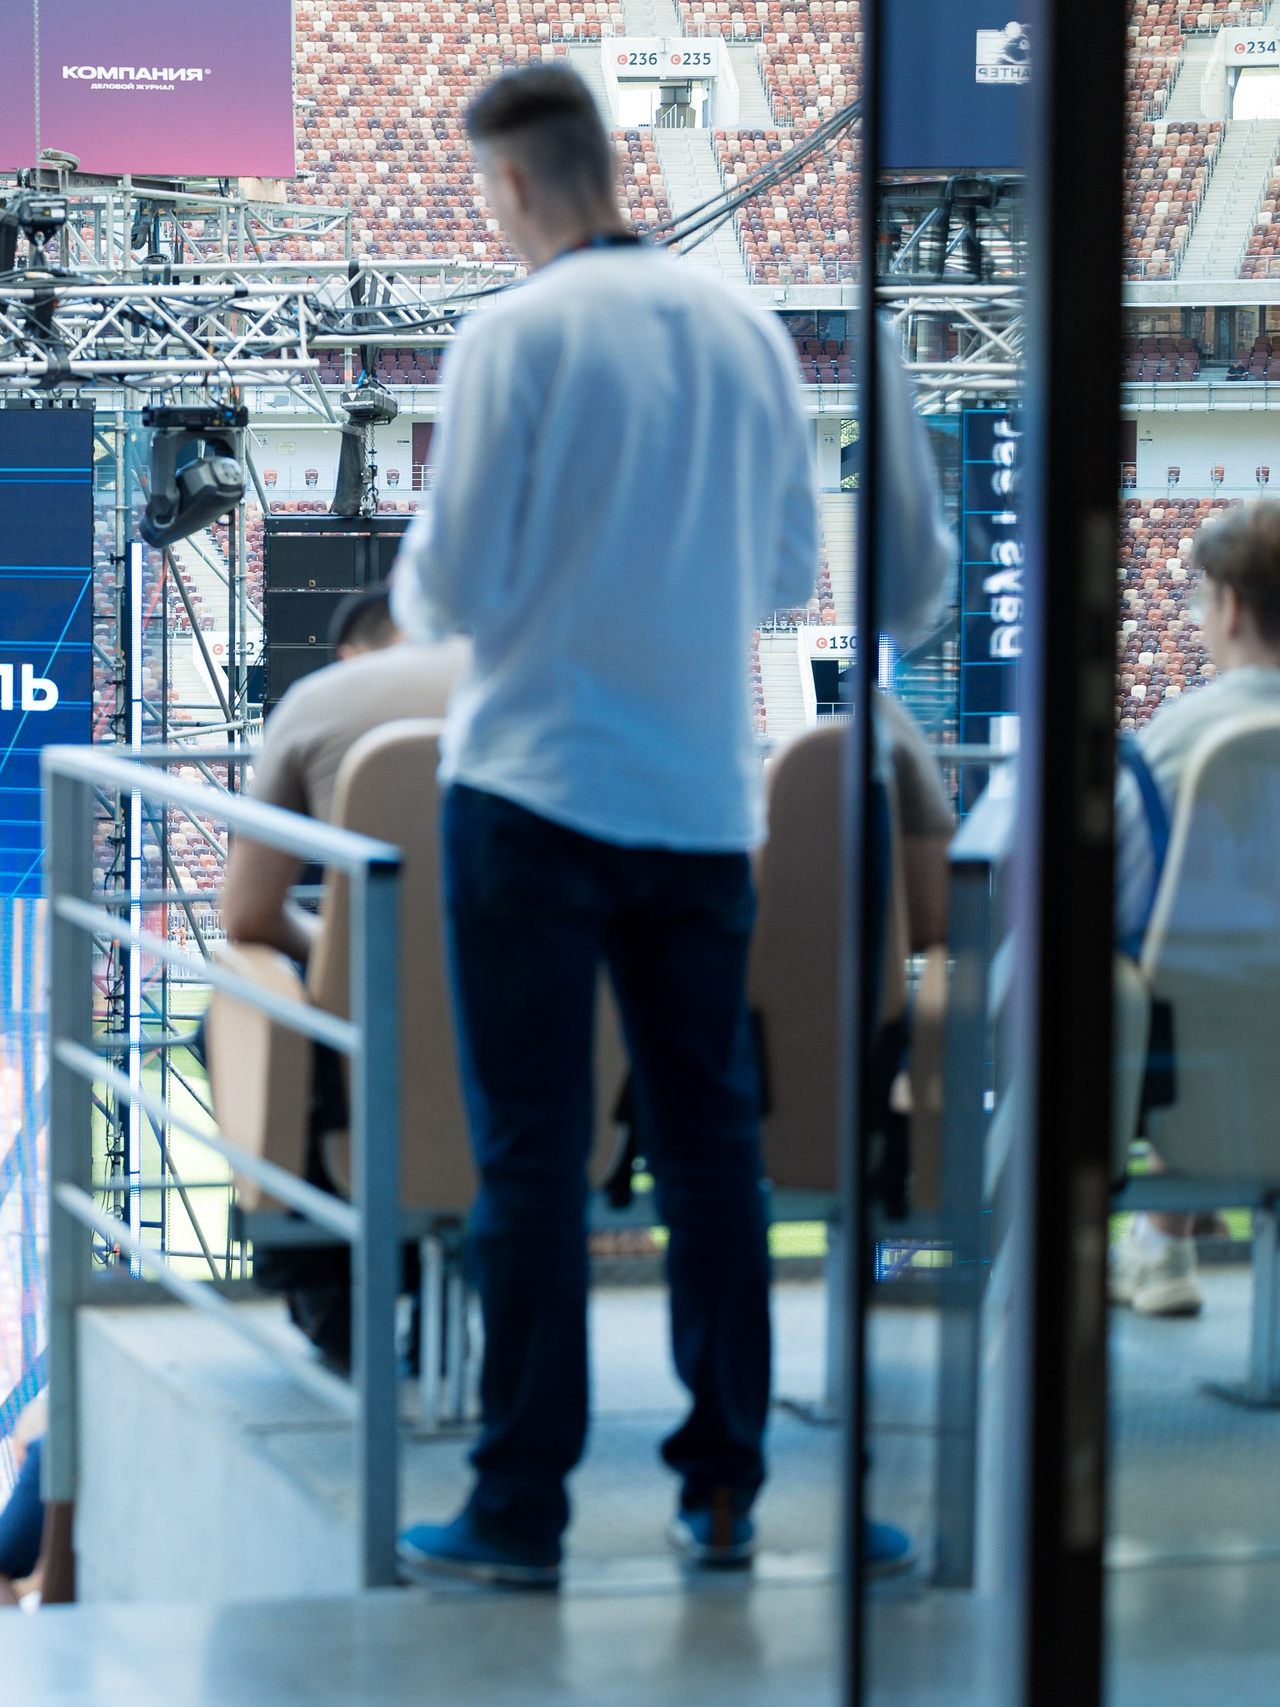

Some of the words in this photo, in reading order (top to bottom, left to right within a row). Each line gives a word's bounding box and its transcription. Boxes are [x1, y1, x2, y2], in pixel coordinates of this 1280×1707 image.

[1246, 41, 1277, 54] 234
[628, 53, 658, 66] 236
[682, 53, 712, 66] 235
